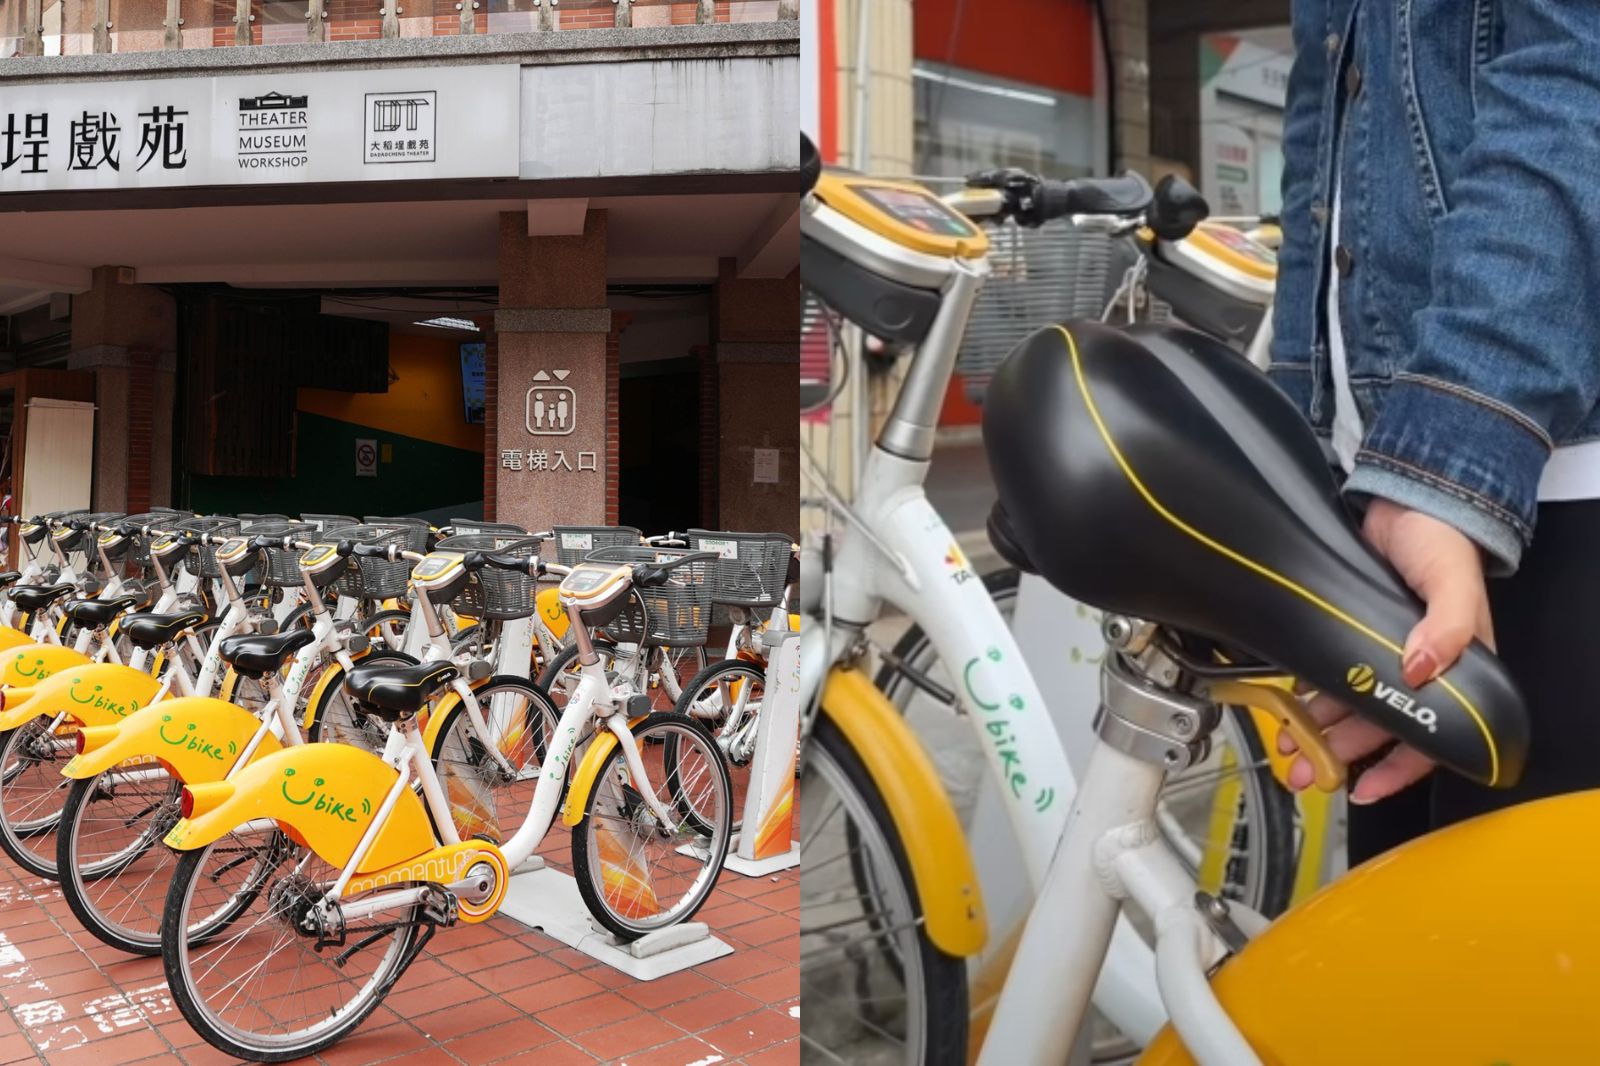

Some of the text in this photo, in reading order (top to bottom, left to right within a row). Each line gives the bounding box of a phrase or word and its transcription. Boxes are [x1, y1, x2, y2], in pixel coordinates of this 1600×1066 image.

[239, 111, 308, 126] THEATER
[0, 105, 189, 174] 埕戲苑
[239, 134, 306, 150] MUSEUM
[238, 156, 308, 169] WORKSHOP
[501, 448, 598, 472] 電梯入口
[1373, 681, 1437, 726] VELO
